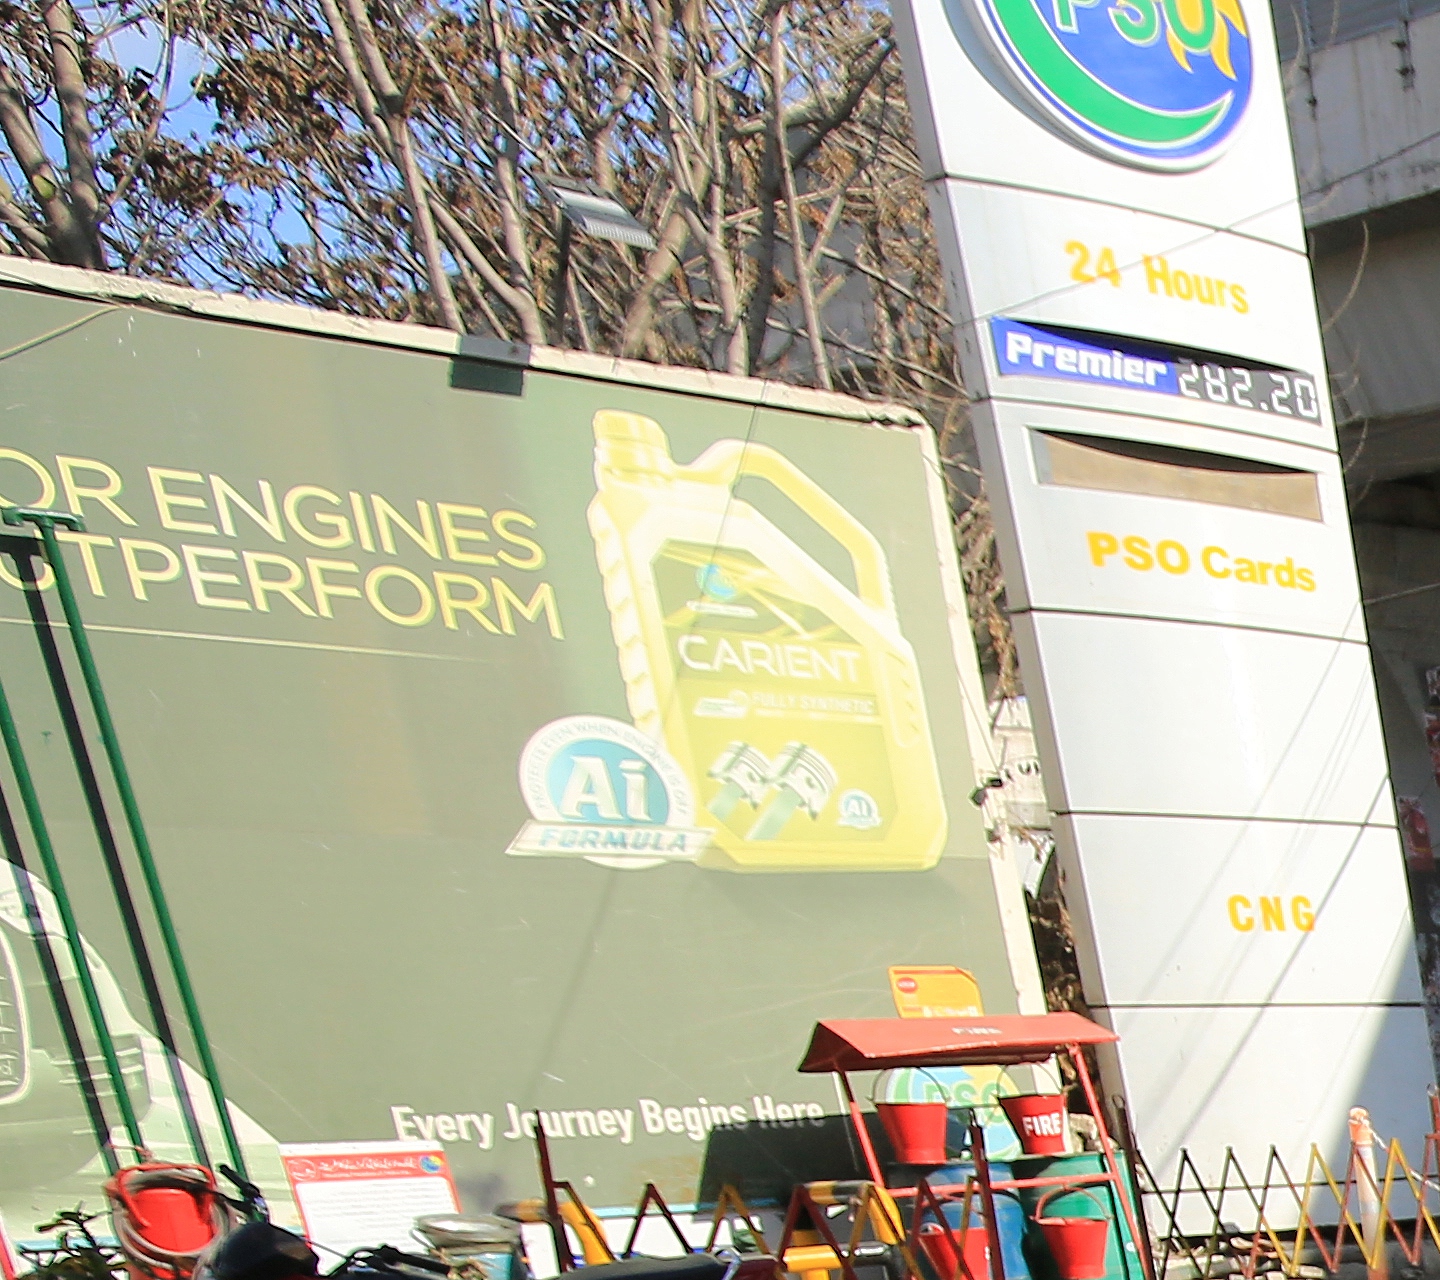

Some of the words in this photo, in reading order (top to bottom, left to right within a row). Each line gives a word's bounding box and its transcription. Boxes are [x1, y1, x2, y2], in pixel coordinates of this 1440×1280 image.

[1065, 240, 1121, 288] 24
[1141, 254, 1250, 314] Hours
[1006, 332, 1167, 387] Premier
[0, 448, 138, 527] OR
[147, 466, 547, 573] ENGINES
[0, 531, 565, 641] TPERFORM
[1086, 531, 1191, 575] PSO
[1202, 546, 1317, 593] Cards
[677, 633, 860, 683] CARIENT
[561, 755, 654, 823] Ai
[538, 827, 688, 853] FORMULA
[1228, 893, 1316, 932] CNG
[390, 1104, 495, 1150] Every
[503, 1099, 637, 1146] Journey
[642, 1097, 763, 1136] Begins
[771, 1095, 826, 1129] Here
[1022, 1112, 1061, 1137] FIRE
